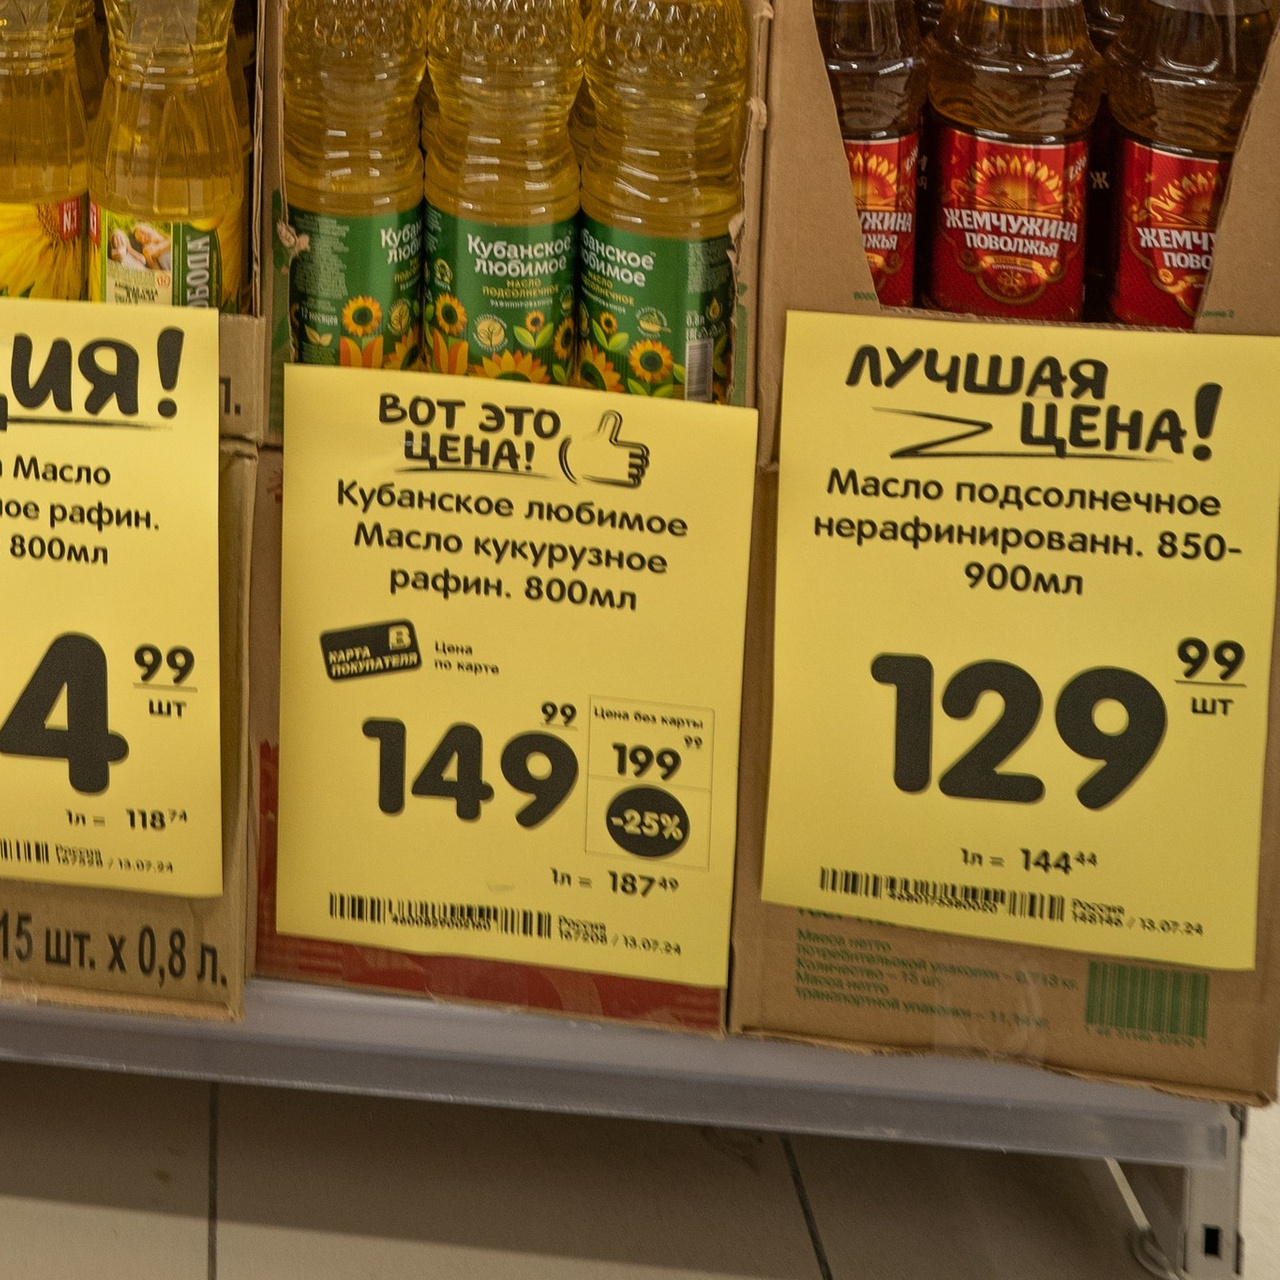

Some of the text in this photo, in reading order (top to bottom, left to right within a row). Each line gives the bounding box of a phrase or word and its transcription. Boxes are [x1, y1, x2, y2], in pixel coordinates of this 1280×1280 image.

[943, 208, 1078, 243] ЖЕМЧУЖИНА
[467, 234, 570, 262] Кубанское
[965, 231, 1058, 257] ПОВОЛЖЬЯ
[474, 255, 567, 280] любимое
[843, 343, 1110, 402] ЛУЧШАЯ
[378, 393, 562, 441] ВОТ ЭТО
[1019, 381, 1224, 463] ЦЕНА!
[402, 426, 537, 473] ЦЕНА!
[12, 454, 111, 486] Масло
[337, 478, 688, 537] Кубанское любимое
[826, 467, 1222, 517] Масло подсолнечное
[49, 501, 159, 533] рафин.
[9, 534, 108, 565] 800мл
[353, 521, 668, 574] Масло кукурузное
[814, 515, 1242, 562] нерафинированн. 850-
[389, 567, 637, 611] рафин. 800мл
[964, 561, 1084, 596] 900мл
[132, 642, 198, 688] 99
[328, 646, 371, 664] КАРТА
[331, 652, 418, 677] ПОКУПАТЕЛЯ
[434, 641, 473, 656] Цена
[434, 659, 453, 670] по
[148, 699, 187, 718] шт
[593, 705, 631, 723] Цена
[1191, 697, 1234, 716] шт
[868, 635, 1247, 813] 129 99
[360, 699, 580, 830] 149 99
[610, 740, 684, 782] 199
[610, 808, 684, 841] -25%
[1019, 847, 1073, 875] 144
[607, 869, 658, 899] 187
[44, 927, 96, 970] шт.
[137, 924, 187, 989] 0,8
[196, 941, 228, 988] л.
